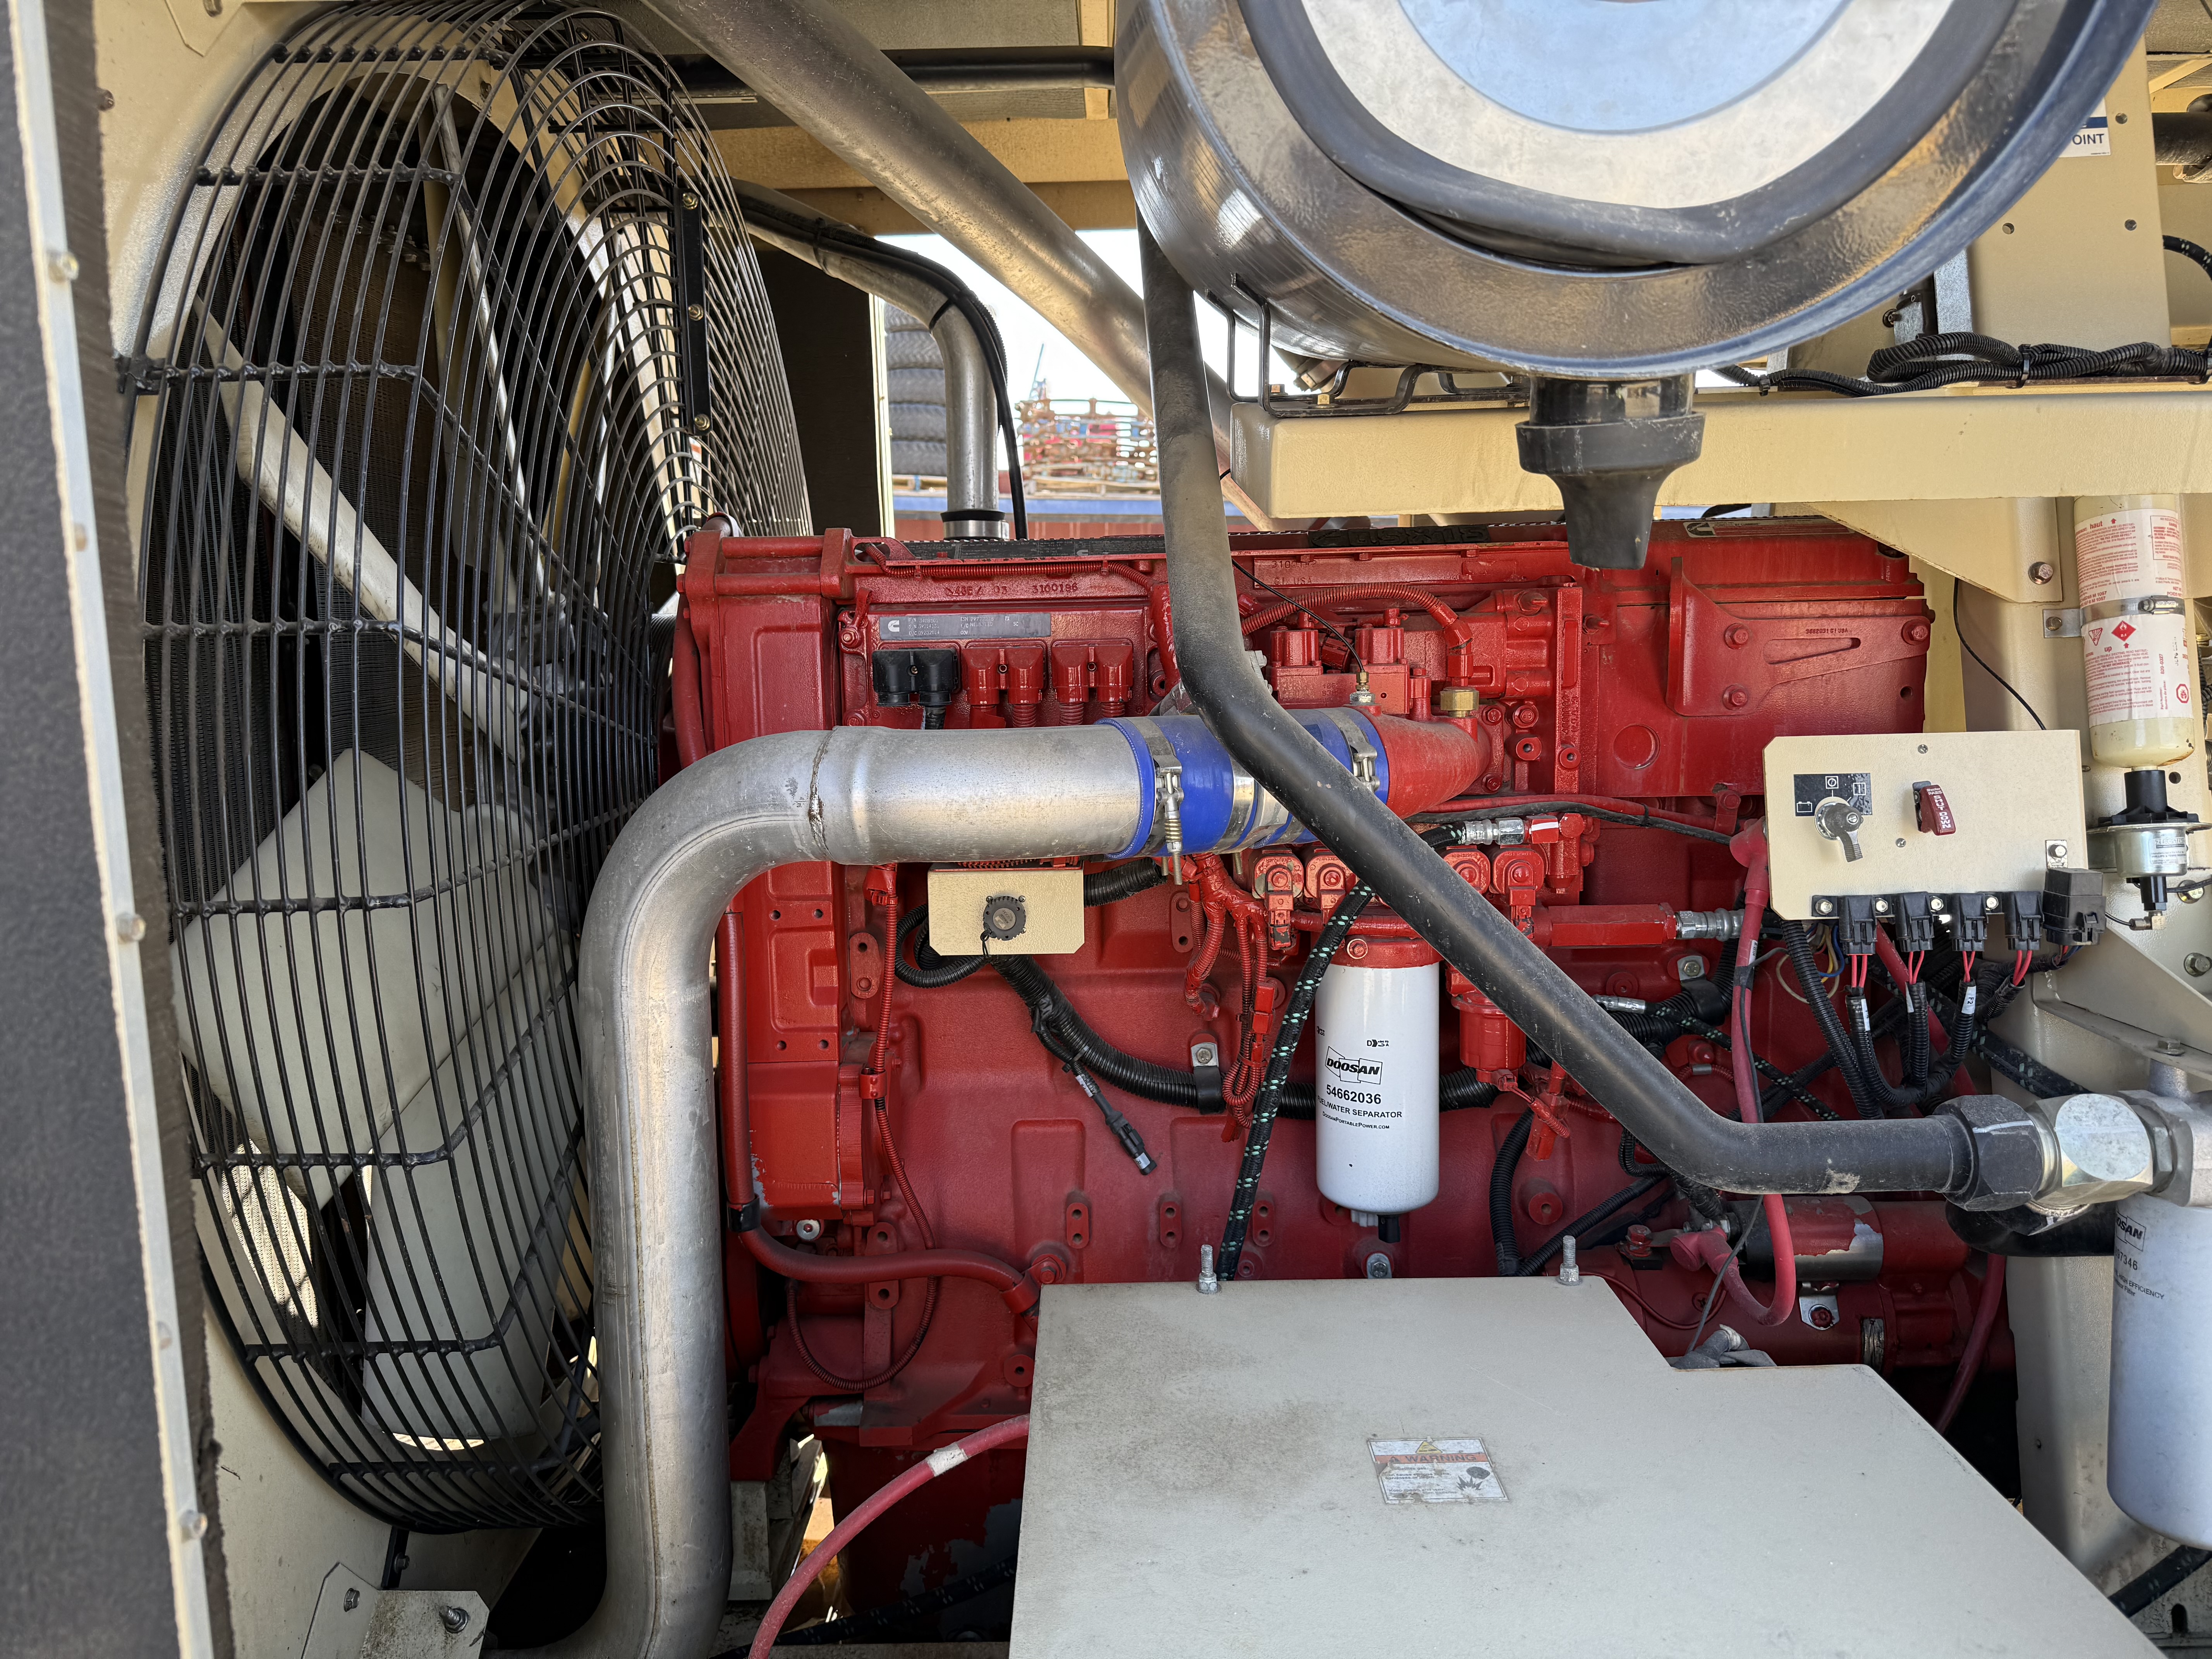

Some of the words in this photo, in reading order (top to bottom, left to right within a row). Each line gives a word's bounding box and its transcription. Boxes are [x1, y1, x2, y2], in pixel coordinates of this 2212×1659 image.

[2072, 133, 2104, 145] OINT
[2090, 521, 2103, 529] haut
[1933, 795, 1945, 811] SHUT
[1939, 812, 1951, 829] DOWN
[1326, 1058, 1380, 1075] DOOSAN
[1326, 1084, 1381, 1104] 54662036
[1317, 1095, 1350, 1114] FUEL/WATER
[1352, 1109, 1402, 1118] SEPARATOR
[2117, 1218, 2143, 1239] OSAN
[2129, 1280, 2165, 1299] EFFICIENCY
[1405, 1455, 1477, 1463] WARNING
